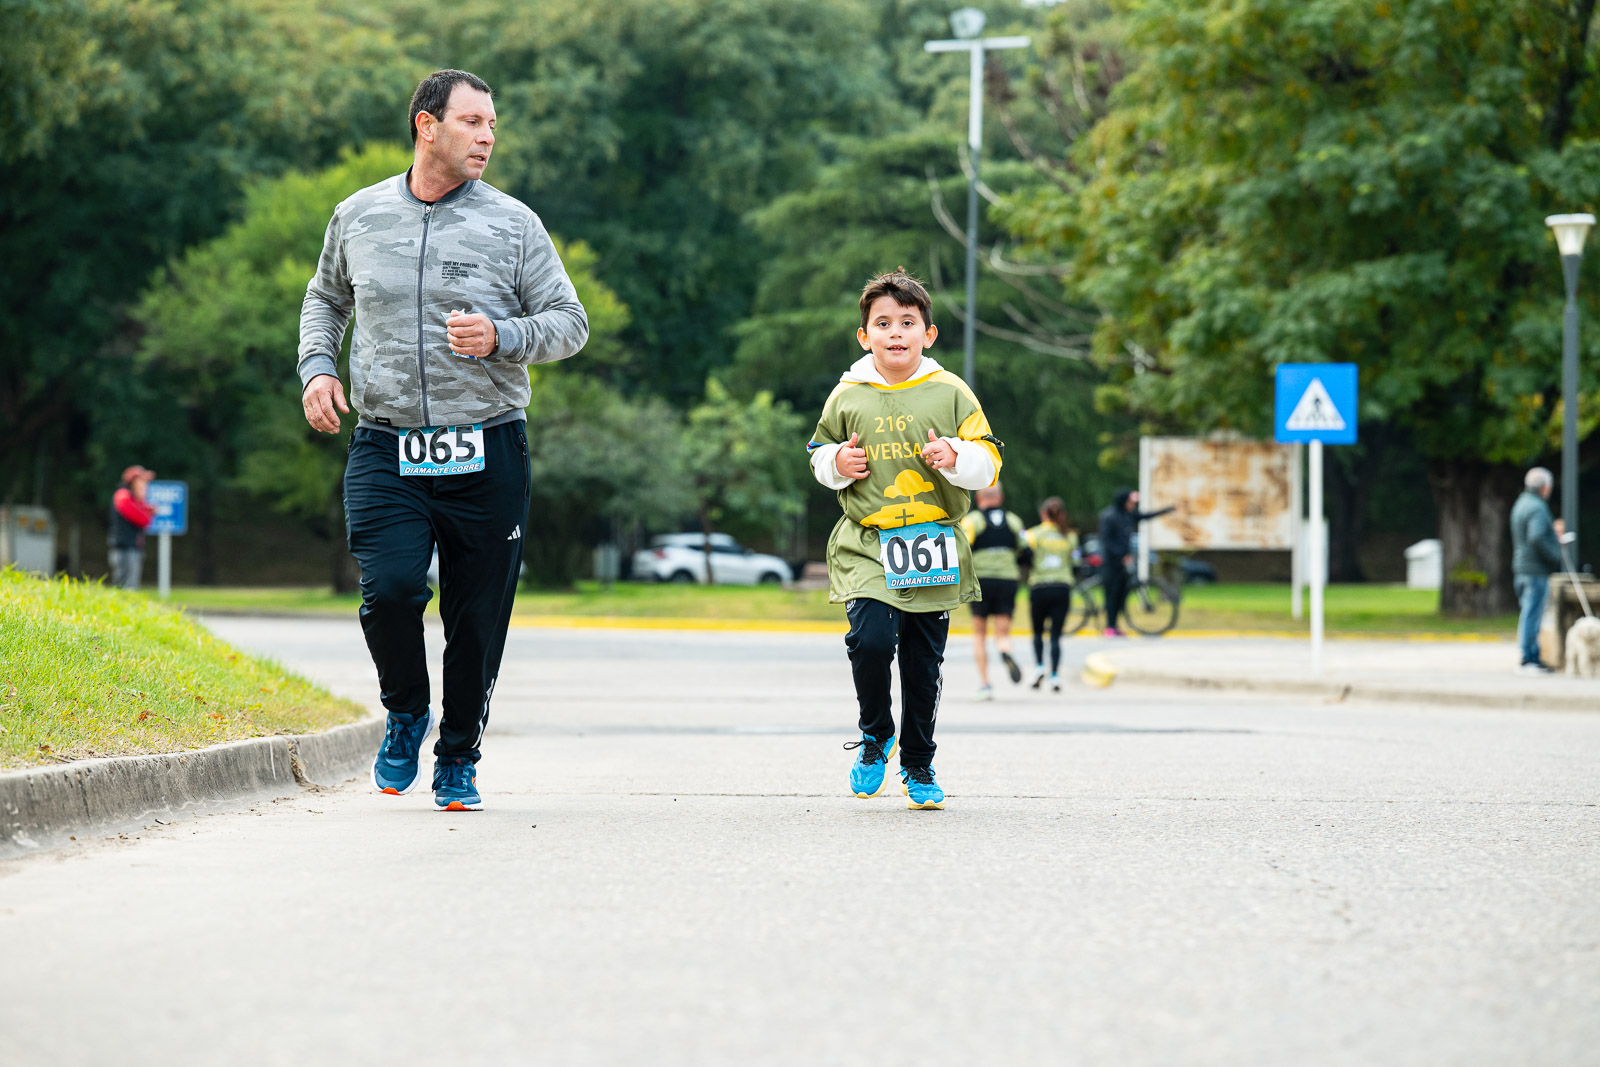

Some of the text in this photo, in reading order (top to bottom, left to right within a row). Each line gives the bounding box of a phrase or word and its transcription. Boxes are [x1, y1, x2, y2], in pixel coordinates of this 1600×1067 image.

[874, 415, 914, 433] 216°
[404, 425, 476, 465] 065
[862, 442, 932, 461] IVERSA
[404, 463, 481, 474] DIAMANTE CORRE
[887, 532, 949, 575] 061
[891, 574, 956, 587] DIAMANTE CORRE
